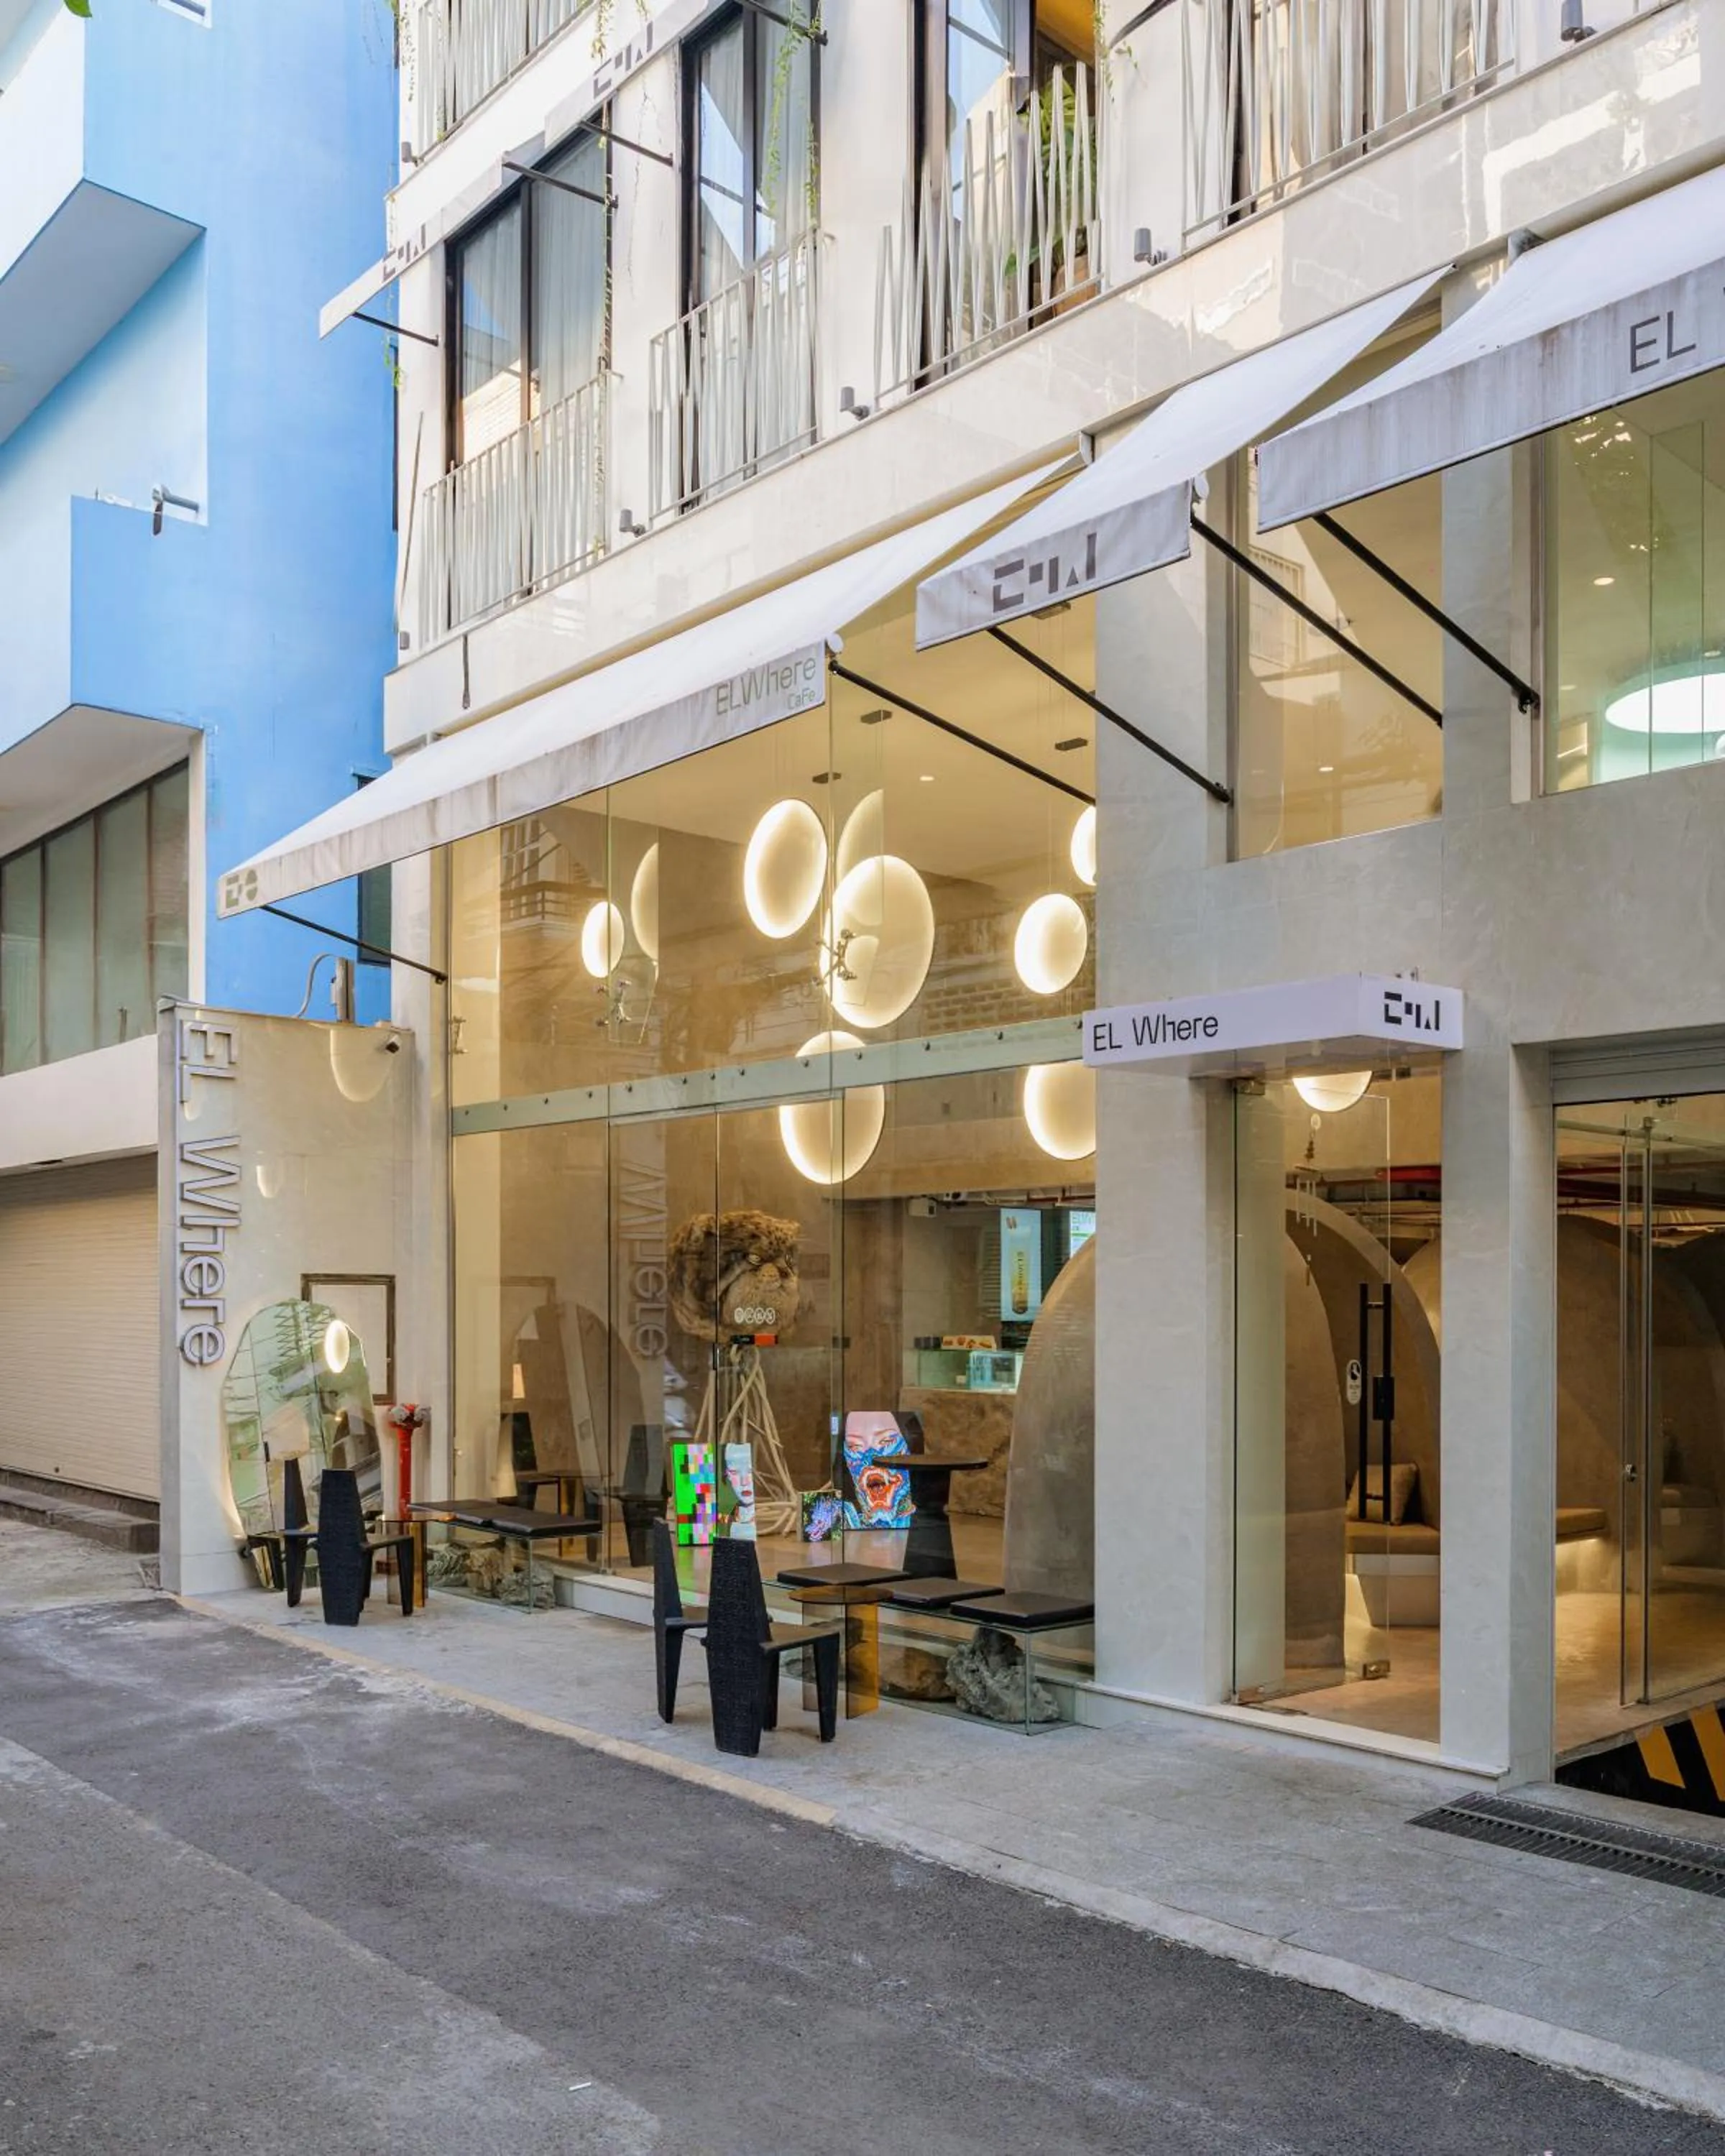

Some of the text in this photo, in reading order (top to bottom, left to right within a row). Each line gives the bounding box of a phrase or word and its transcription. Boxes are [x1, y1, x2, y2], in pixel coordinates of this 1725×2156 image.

[1630, 310, 1696, 373] EL
[1093, 1013, 1219, 1052] EL Where
[180, 1020, 242, 1367] EL Where
